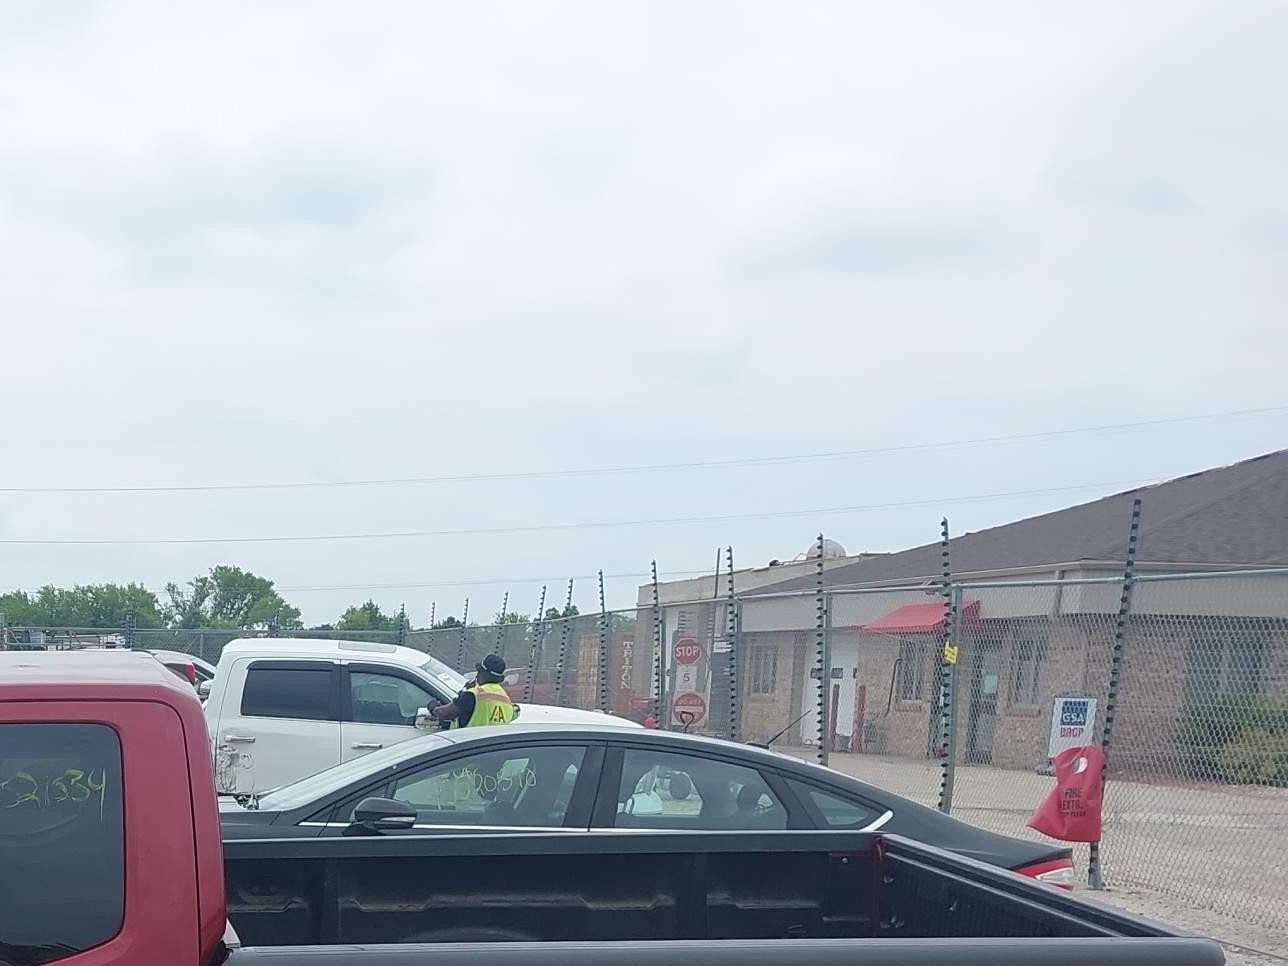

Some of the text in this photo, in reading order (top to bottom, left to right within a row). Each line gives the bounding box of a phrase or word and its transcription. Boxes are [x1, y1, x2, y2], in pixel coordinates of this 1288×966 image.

[675, 645, 700, 658] STOP
[620, 641, 633, 688] TRITON
[683, 672, 691, 682] 5
[1062, 712, 1085, 722] GSA
[1059, 727, 1084, 738] DROP
